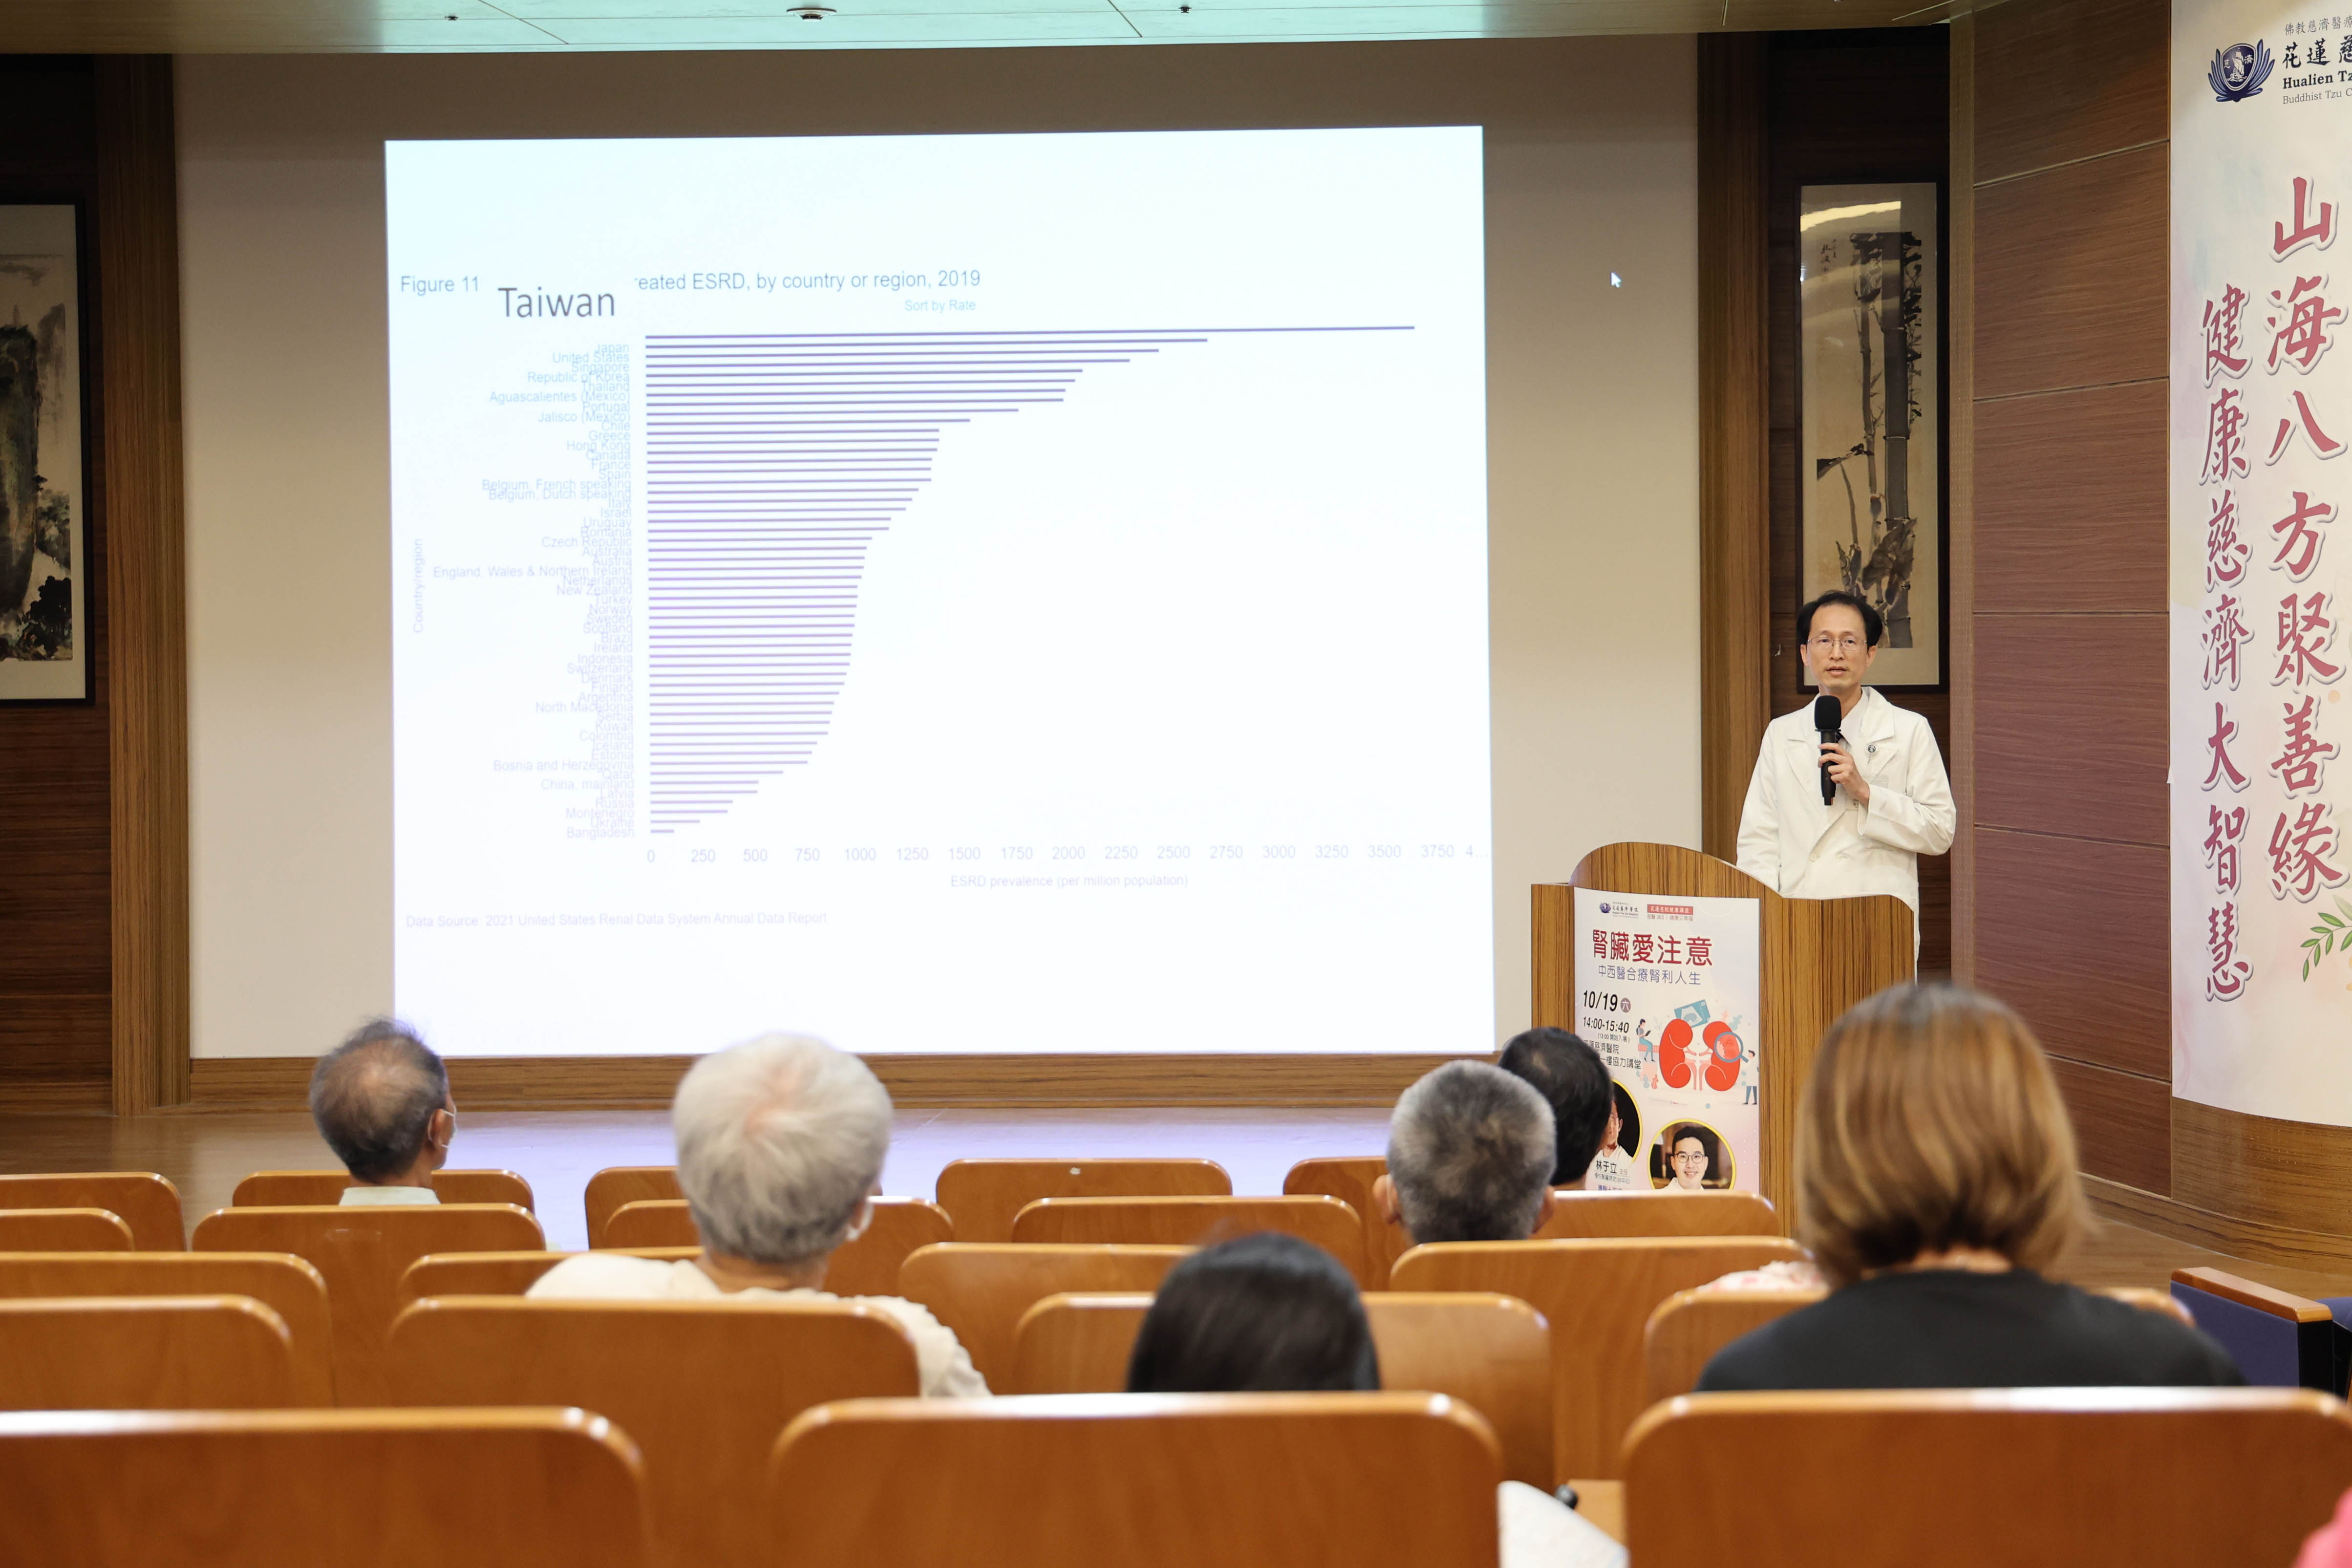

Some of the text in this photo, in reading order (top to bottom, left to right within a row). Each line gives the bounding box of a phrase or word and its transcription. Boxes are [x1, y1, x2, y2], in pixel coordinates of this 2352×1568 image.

[2283, 73, 2333, 89] Hualien
[2283, 92, 2322, 104] Buddhist
[2325, 90, 2342, 98] Tzu
[400, 275, 480, 296] Figure 11
[692, 272, 750, 292] ESRD,
[757, 272, 777, 293] by
[782, 272, 845, 292] country
[851, 275, 868, 288] or
[874, 271, 932, 292] region,
[938, 270, 981, 287] 2019
[497, 286, 615, 318] Taiwan
[905, 300, 976, 313] Sort by Rate
[594, 344, 630, 355] Japan
[552, 352, 630, 363] United States
[571, 363, 630, 374] Singapore
[528, 371, 578, 385] Republic
[596, 371, 630, 382] Korea
[582, 381, 630, 391] Thailand
[489, 391, 630, 405] Aguascalientes (Mexico)
[582, 402, 630, 414] Portugal
[538, 411, 630, 424] Jalisco (Mexico)
[601, 420, 630, 430] Chile
[589, 430, 630, 440] Greece
[567, 440, 630, 453] Hong Kong
[586, 451, 631, 461] Canada
[592, 459, 631, 470] France
[599, 469, 631, 481] Spain
[536, 479, 576, 490] French
[579, 479, 631, 493] speaking
[489, 489, 631, 502] Belgium, Dutch speaking
[609, 498, 631, 511] Italy
[600, 508, 631, 517] Israel
[583, 517, 631, 530] Uruguay
[581, 527, 631, 537] Romania
[2266, 176, 2344, 896] 山海八方聚善緣
[542, 536, 632, 549] Czech Republic
[582, 547, 632, 557] Australia
[592, 556, 632, 566] Austria
[433, 564, 632, 580] England, Wales & Northern Ireland
[563, 575, 632, 585] Netherlands
[556, 584, 632, 595] New Zealand
[595, 594, 632, 606] Turkey
[590, 604, 633, 616] Norway
[587, 614, 632, 624] Sweden
[583, 623, 633, 634] Scotland
[601, 633, 633, 643] Brazil
[2201, 282, 2250, 995] 健康慈濟大智慧
[594, 643, 633, 653] Ireland
[577, 653, 633, 664] Indonesia
[567, 663, 633, 674] Switzerland
[581, 672, 633, 683] Denmark
[592, 682, 633, 692] Finland
[579, 691, 633, 704] Argentina
[535, 701, 633, 712] North Macedonia
[597, 710, 633, 721] Serbia
[596, 720, 633, 731] Kuwait
[579, 730, 633, 741] Colombia
[594, 740, 633, 751] Iceland
[592, 750, 634, 760] Estonia
[493, 759, 634, 772] Bosnia and Herzegovina
[602, 769, 633, 779] Qatar
[582, 778, 634, 790] mainland
[601, 788, 634, 798] Latvia
[595, 797, 634, 809] Russia
[566, 807, 635, 820] Montenegro
[590, 817, 634, 828] Ukraine
[567, 826, 635, 840] Bangladesh
[646, 849, 655, 862] 0
[691, 849, 716, 862] 250
[743, 849, 768, 862] 500
[795, 848, 820, 861] 750
[844, 848, 876, 861] 1000
[896, 847, 929, 860] 1250
[949, 847, 981, 860] 1500
[1001, 847, 1033, 860] 1750
[1052, 846, 1086, 860] 2000
[1105, 846, 1138, 859] 2250
[1157, 846, 1191, 859] 2500
[1210, 845, 1243, 859] 2750
[1262, 845, 1296, 859] 3000
[1315, 844, 1349, 859] 3250
[1368, 844, 1401, 858] 3500
[1421, 844, 1454, 858] 3750
[950, 874, 1189, 890] ESRD prevalence (per million population)
[406, 911, 827, 927] Data Source: 2021 United States Renal Data System Annual Data Report
[1593, 929, 1712, 966] 腎臟愛注意
[1599, 964, 1701, 986] 中西醫合療腎利人生
[1583, 990, 1630, 1012] 10/19 六
[1583, 1016, 1629, 1033] 14:00-15:40
[1596, 1159, 1617, 1174] 林于立
